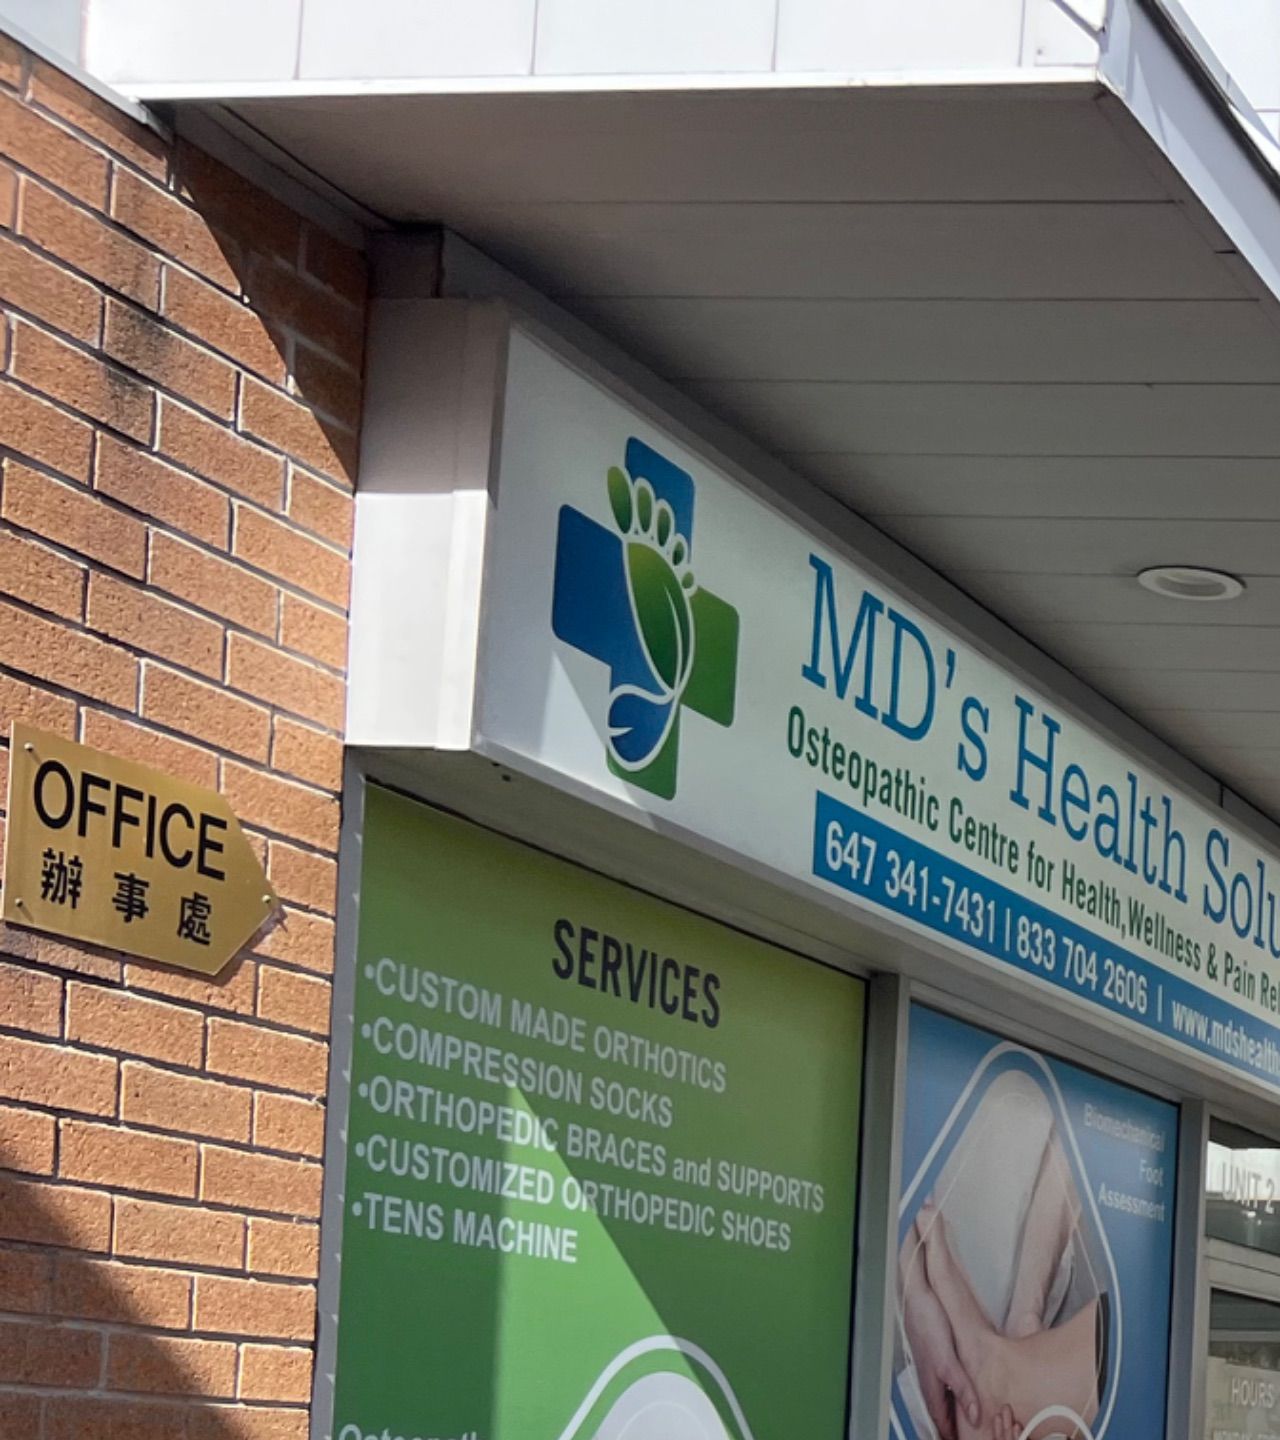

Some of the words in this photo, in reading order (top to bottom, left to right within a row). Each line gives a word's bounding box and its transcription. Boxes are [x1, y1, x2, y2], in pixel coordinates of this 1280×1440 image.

[801, 553, 989, 782] MD's
[1008, 694, 1188, 904] Health
[33, 759, 228, 882] OFFICE
[787, 705, 940, 832] Osteopathic
[949, 796, 1020, 875] Centre
[1027, 840, 1055, 892] for
[1206, 942, 1218, 982] &
[1223, 951, 1256, 1002] Pain
[825, 820, 877, 886] 647
[884, 849, 996, 944] 341-7431
[1016, 915, 1056, 971] 833
[1062, 936, 1098, 991] 704
[1102, 958, 1148, 1014] 2606
[551, 918, 721, 1029] SERVICES
[510, 998, 587, 1052] MADE
[593, 1025, 727, 1094] ORTHOTICS
[589, 1076, 674, 1129] SOCKS
[566, 1123, 667, 1177] BRACES
[672, 1155, 711, 1187] and
[716, 1160, 825, 1214] SUPPORTS
[1098, 1182, 1165, 1223] Assessment
[1139, 1159, 1164, 1187] Foot
[1222, 1161, 1262, 1209] UNIT
[1265, 1177, 1276, 1216] 2
[452, 1208, 578, 1264] MACHINE
[561, 1175, 715, 1239] ORTHOPEDIC
[721, 1208, 792, 1253] SHOES
[1231, 1376, 1276, 1409] HOURS
